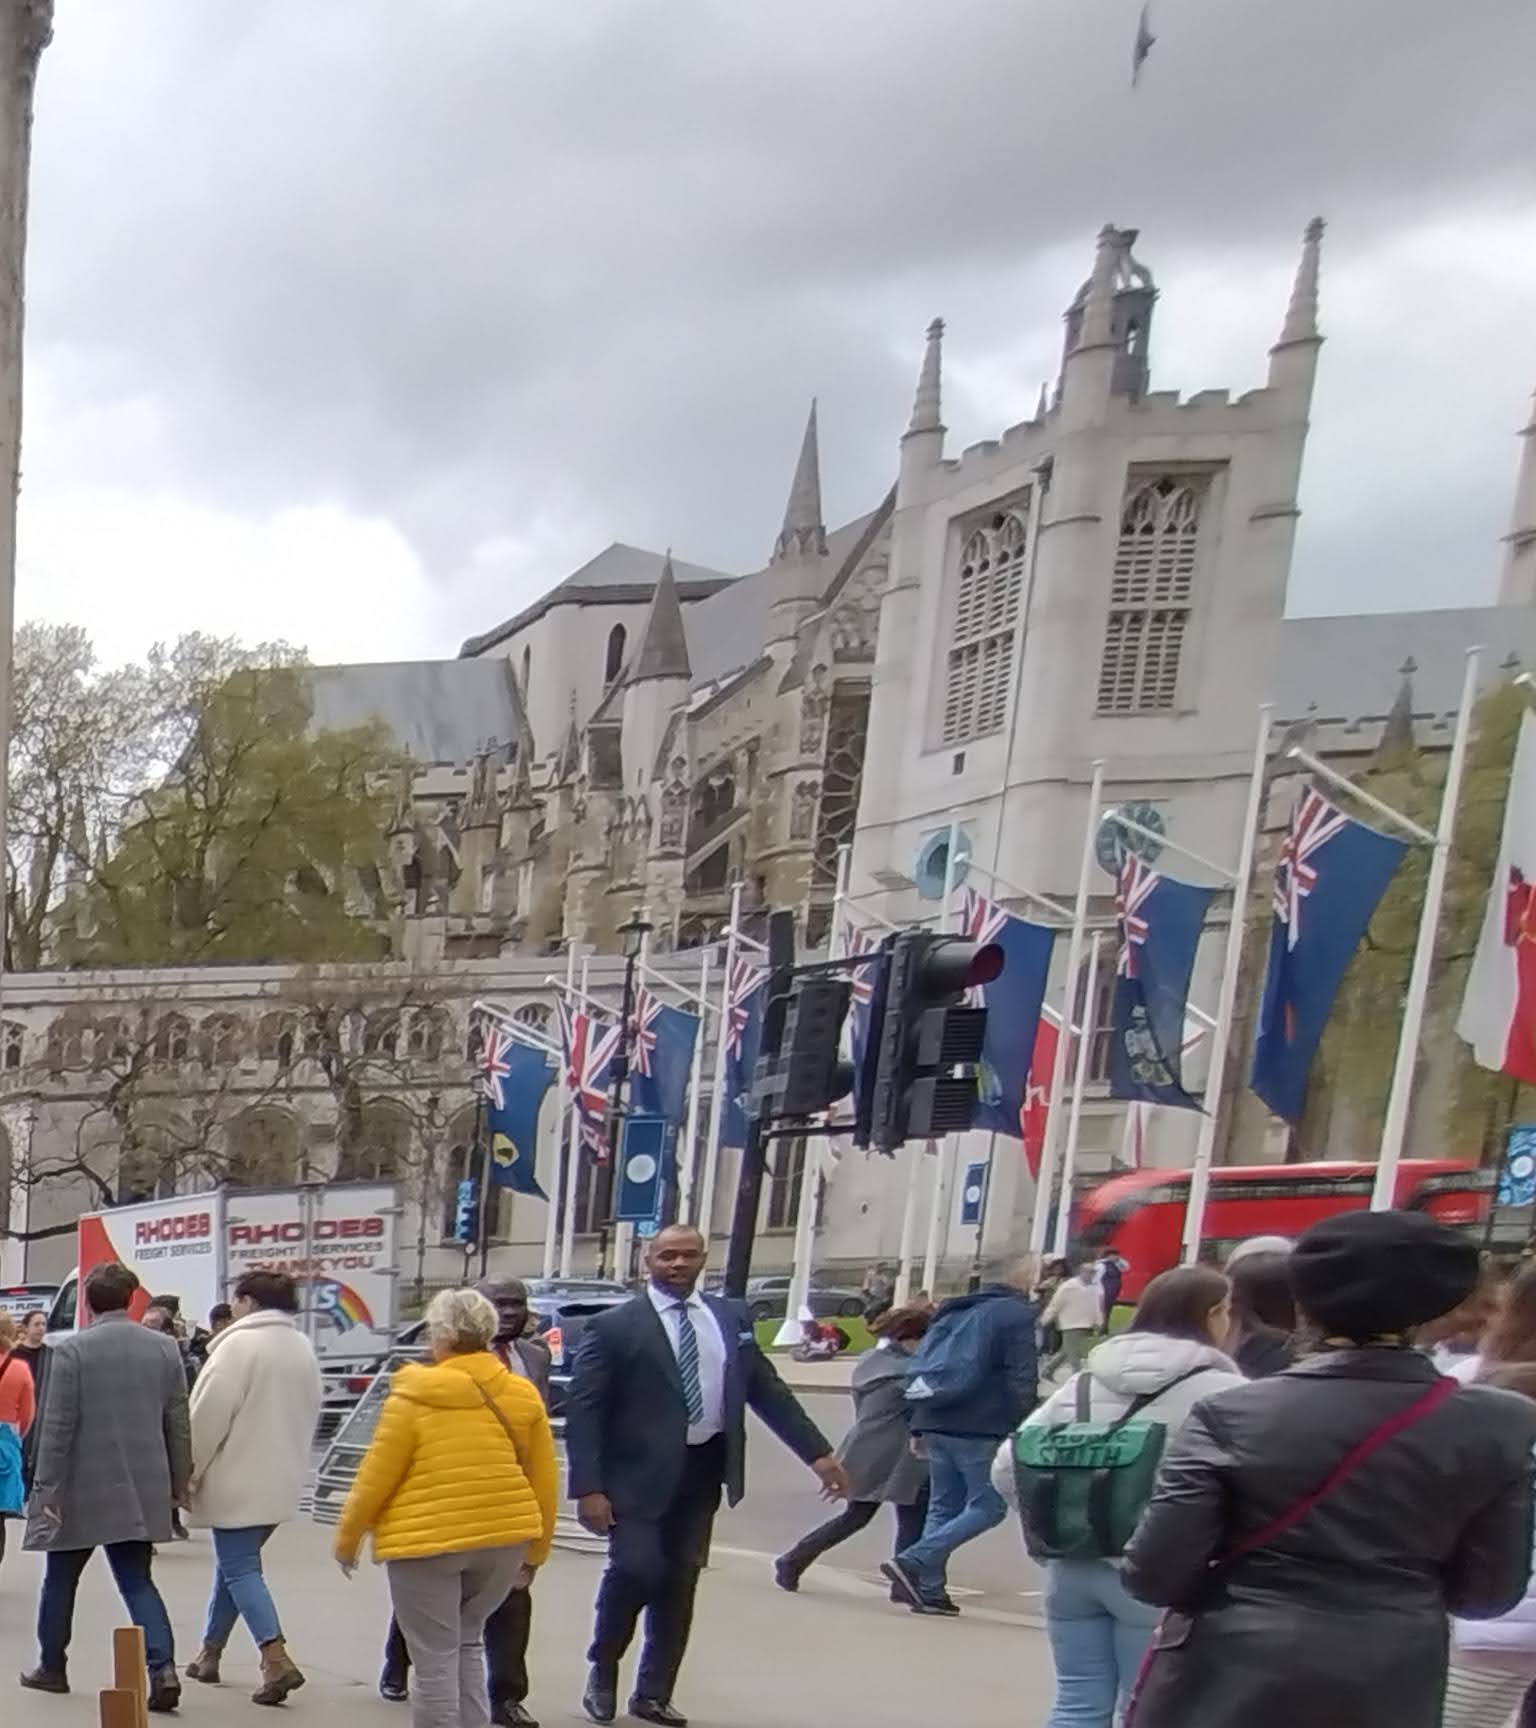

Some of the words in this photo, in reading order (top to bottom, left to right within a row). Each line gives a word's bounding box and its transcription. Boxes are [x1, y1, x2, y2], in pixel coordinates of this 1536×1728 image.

[135, 1246, 168, 1261] FREIGHT
[169, 1241, 212, 1257] SERVICES
[230, 1246, 296, 1260] FREIGHT
[313, 1242, 383, 1255] SERVICES
[328, 1256, 374, 1271] YOU
